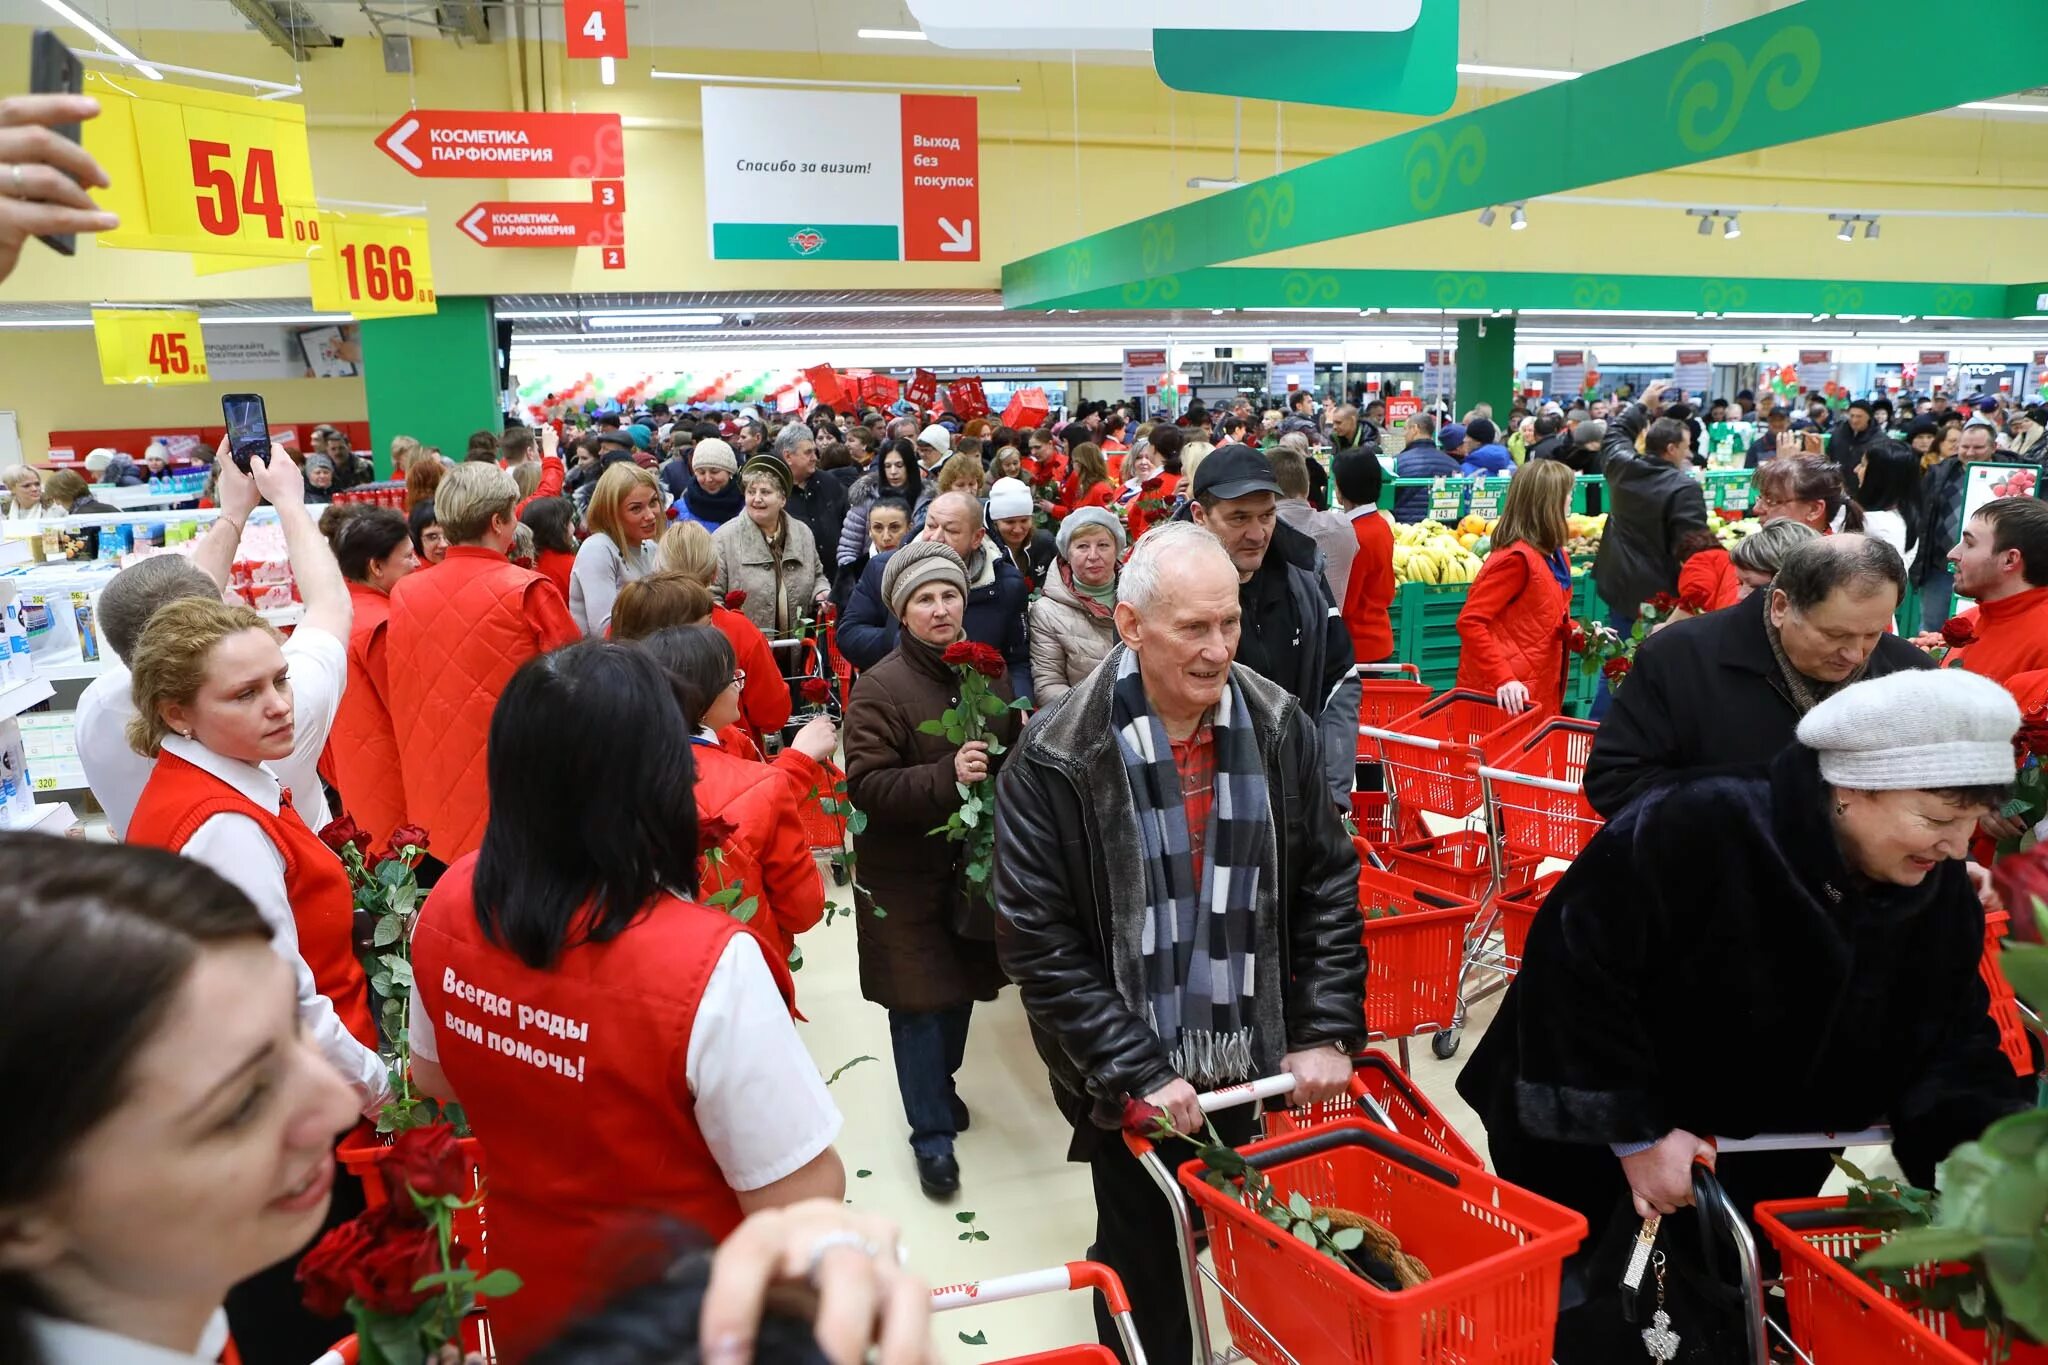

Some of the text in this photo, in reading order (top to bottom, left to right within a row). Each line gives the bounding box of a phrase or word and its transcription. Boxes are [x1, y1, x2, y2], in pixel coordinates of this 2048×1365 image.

[582, 11, 606, 41] 4
[430, 128, 529, 145] КОСМЕТИКА
[913, 135, 960, 151] Выход
[431, 146, 553, 162] ПАРФЮМЕРИЯ
[913, 154, 939, 167] без
[736, 159, 872, 174] Спасибо за визит!
[189, 139, 284, 239] 54
[914, 175, 974, 190] покупок
[602, 187, 615, 205] 3
[492, 213, 559, 225] КОСМЕТИКА
[493, 225, 576, 236] ПАРФЮМЕРИЯ
[608, 252, 618, 264] 2
[340, 244, 414, 301] 166
[149, 333, 190, 375] 45
[443, 966, 589, 1043] Всегда рады
[445, 1010, 586, 1083] вам помочь!
